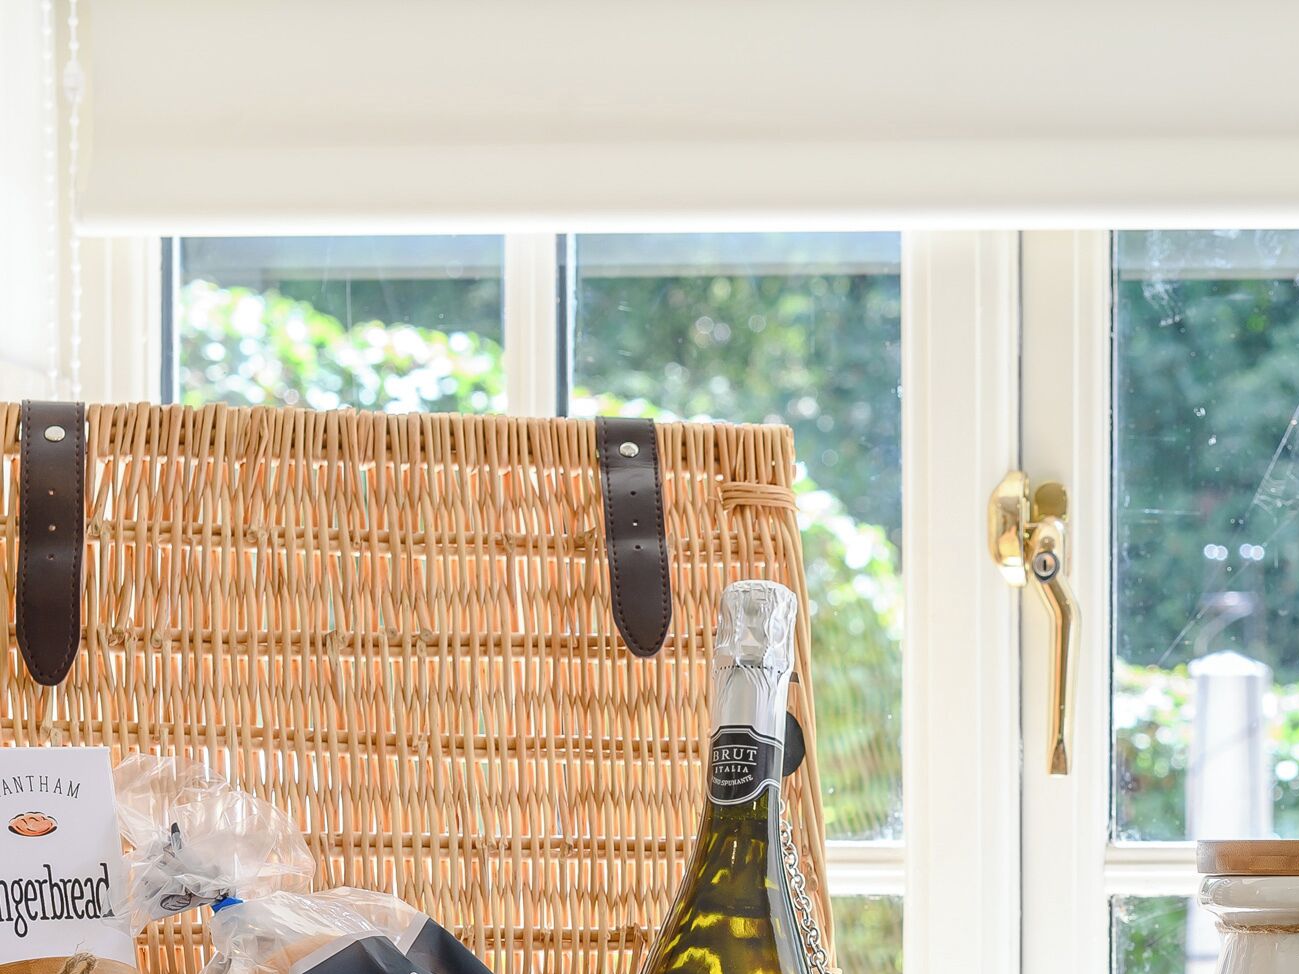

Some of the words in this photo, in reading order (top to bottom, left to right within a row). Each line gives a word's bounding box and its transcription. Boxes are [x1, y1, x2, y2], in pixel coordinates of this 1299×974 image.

[712, 748, 757, 761] BRUT
[715, 765, 749, 773] ITALIA
[0, 775, 81, 799] ANTHAM
